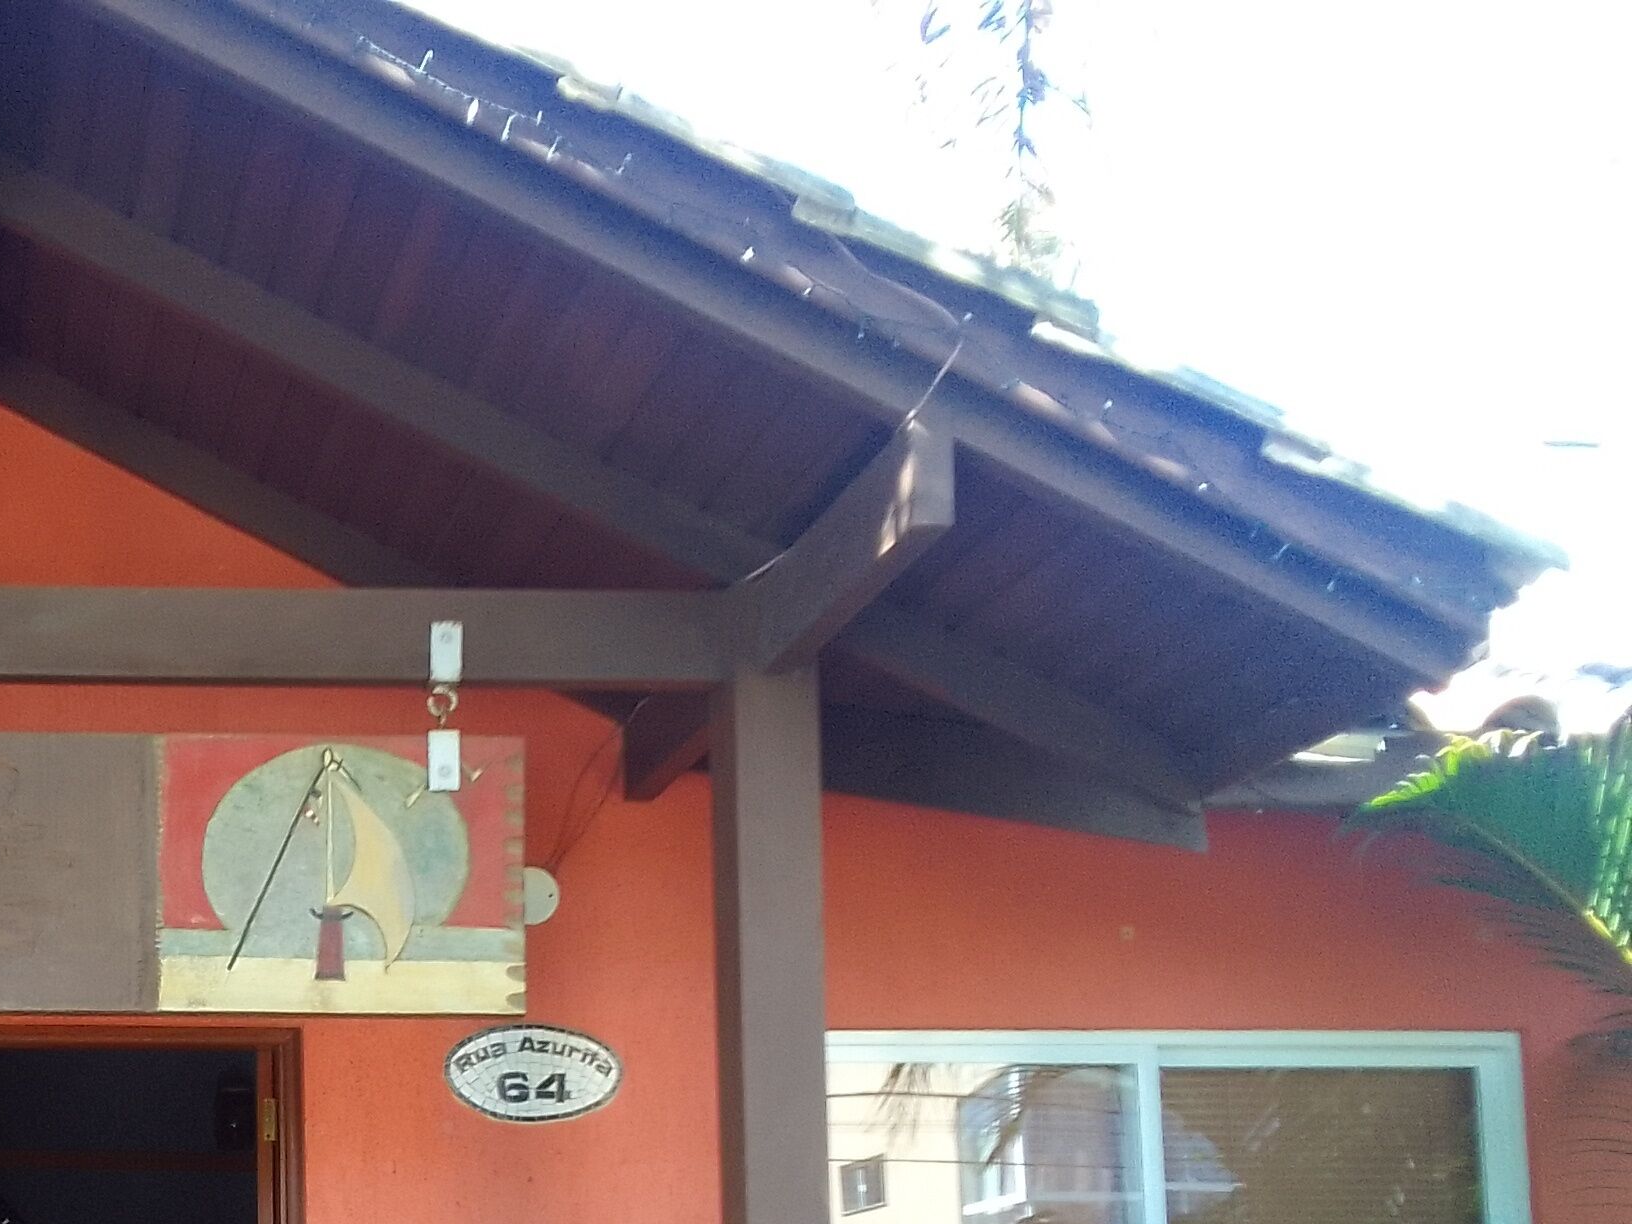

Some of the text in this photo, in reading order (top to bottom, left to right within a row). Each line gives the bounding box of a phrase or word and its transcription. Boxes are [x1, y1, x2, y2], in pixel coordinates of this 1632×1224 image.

[452, 1036, 614, 1078] Rua Azurita
[497, 1071, 571, 1103] 64
